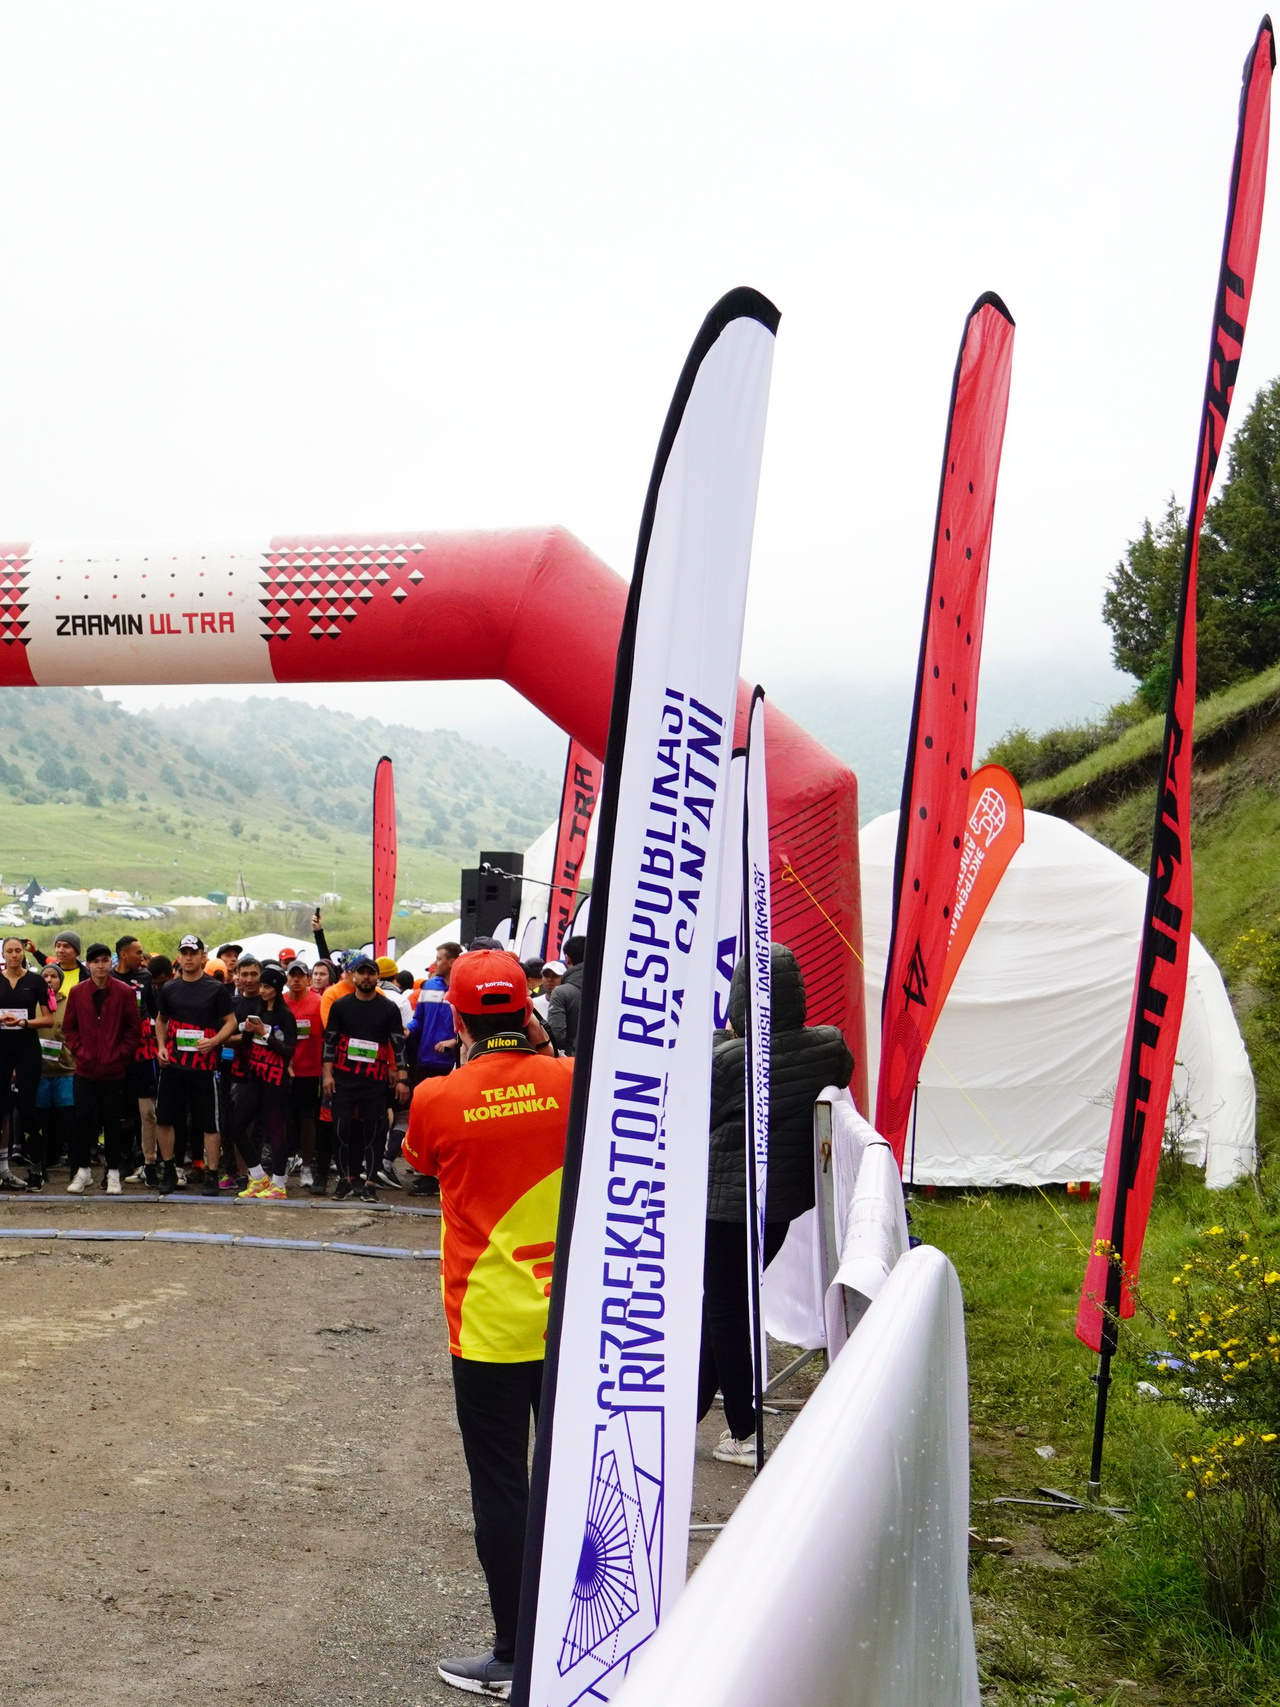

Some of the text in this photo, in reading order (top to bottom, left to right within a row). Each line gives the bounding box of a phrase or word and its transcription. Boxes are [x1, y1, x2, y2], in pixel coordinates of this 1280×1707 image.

[56, 612, 235, 636] ZAAMIN ULTRA
[487, 1038, 518, 1049] Nikon
[481, 1083, 536, 1103] TEAM
[463, 1096, 560, 1123] KORZINKA
